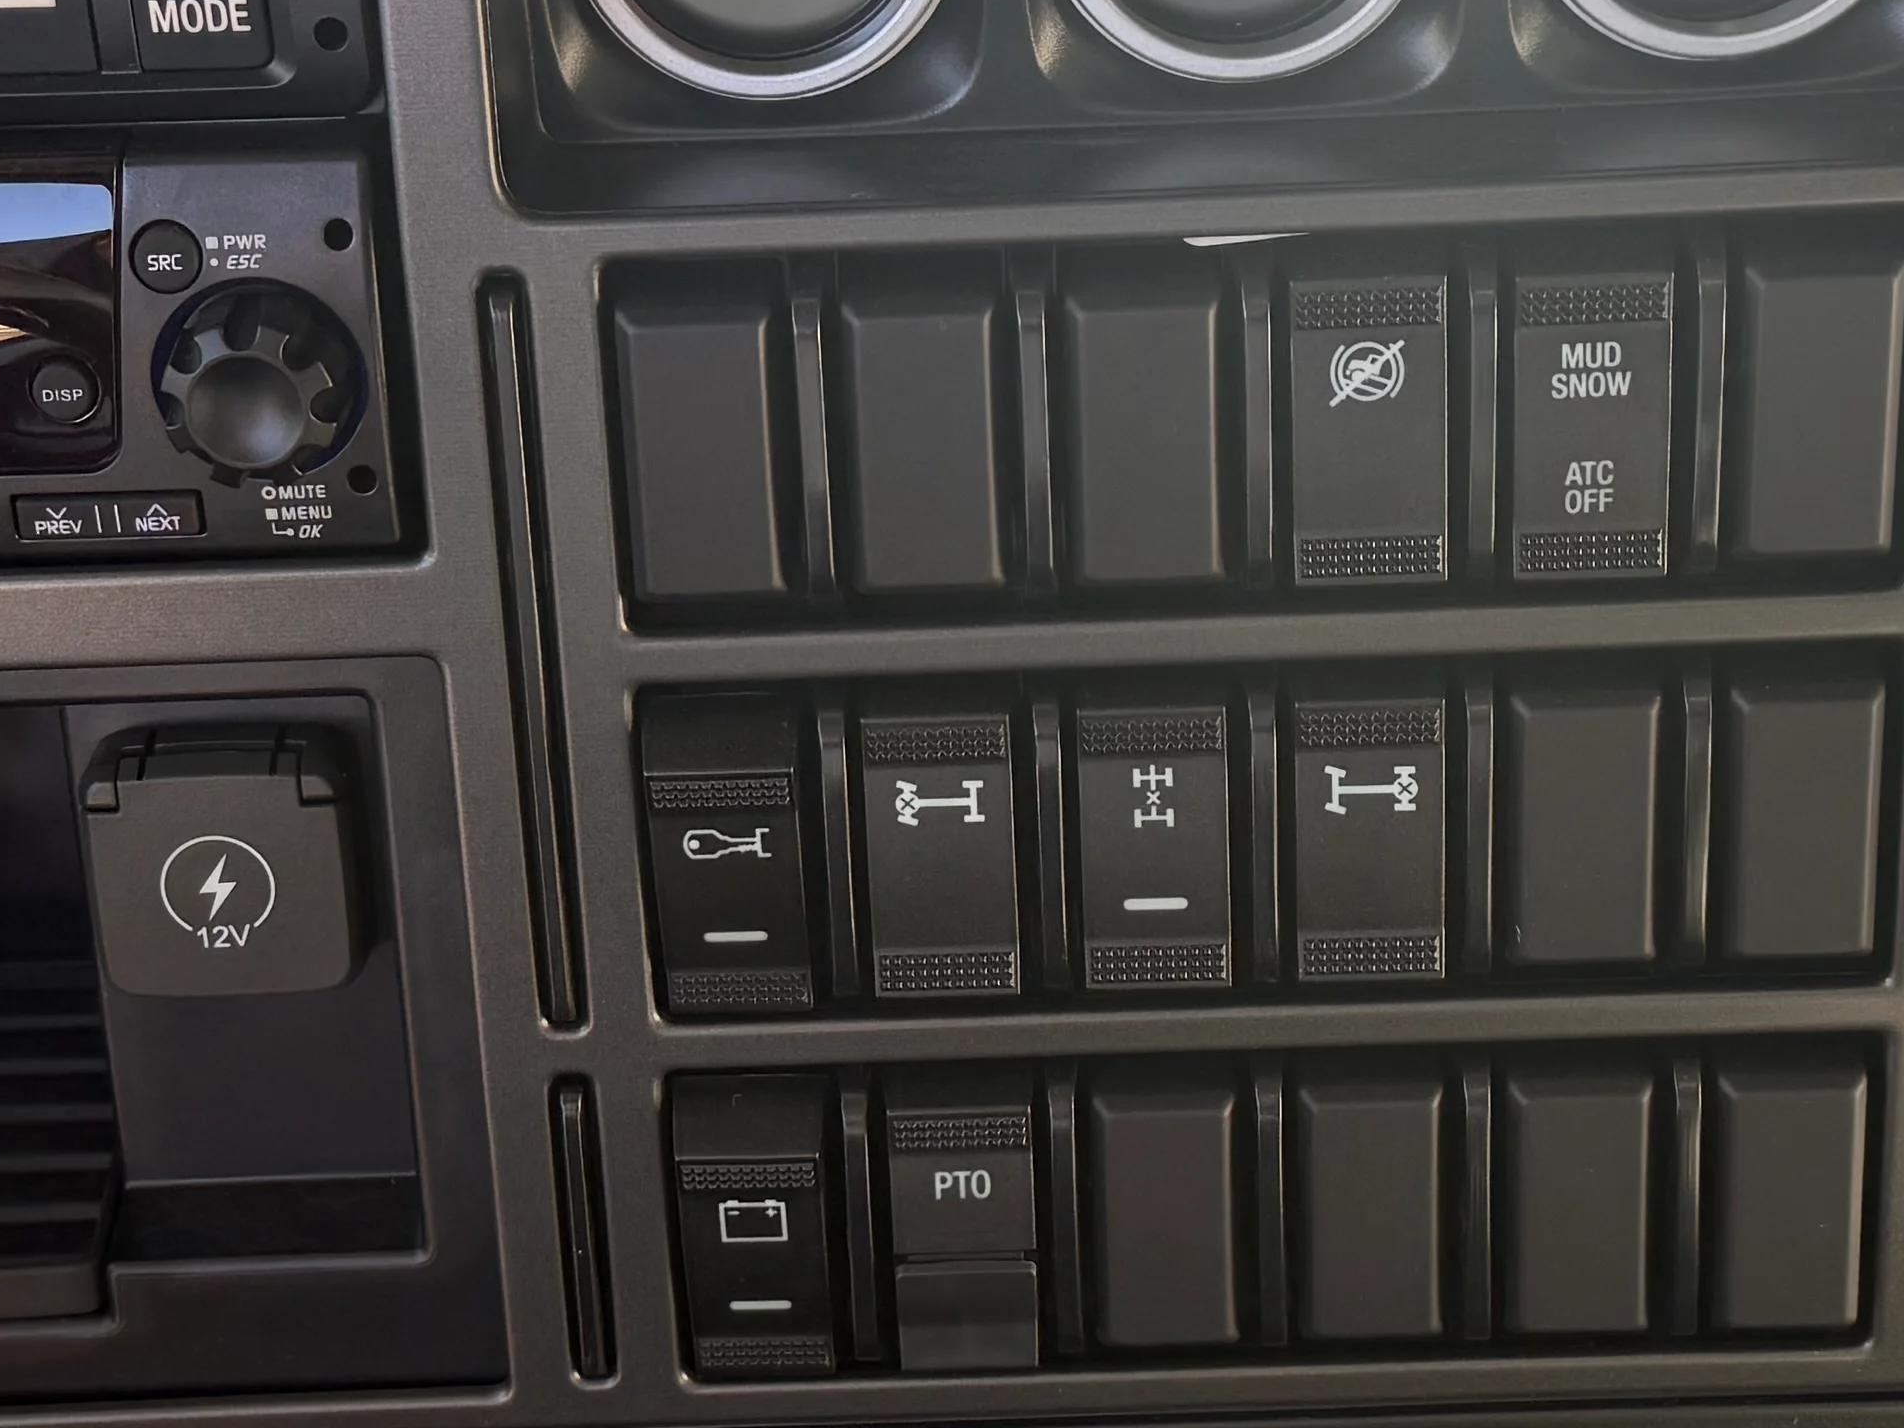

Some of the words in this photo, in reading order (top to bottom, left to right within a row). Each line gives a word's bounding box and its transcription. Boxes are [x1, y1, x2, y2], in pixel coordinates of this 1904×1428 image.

[222, 234, 267, 251] PWR
[147, 253, 183, 271] SRC
[226, 254, 263, 270] ESC
[1560, 341, 1622, 370] MUD
[1550, 371, 1632, 400] SNOW
[42, 388, 84, 402] DISP
[1564, 460, 1614, 486] ATC
[277, 484, 327, 500] MUTE
[1564, 488, 1614, 514] OFF
[281, 504, 333, 521] MENU
[34, 518, 83, 535] PREV
[135, 515, 181, 532] NEXT
[298, 524, 324, 539] OK
[197, 923, 251, 949] 12V
[934, 1170, 992, 1201] PTO
